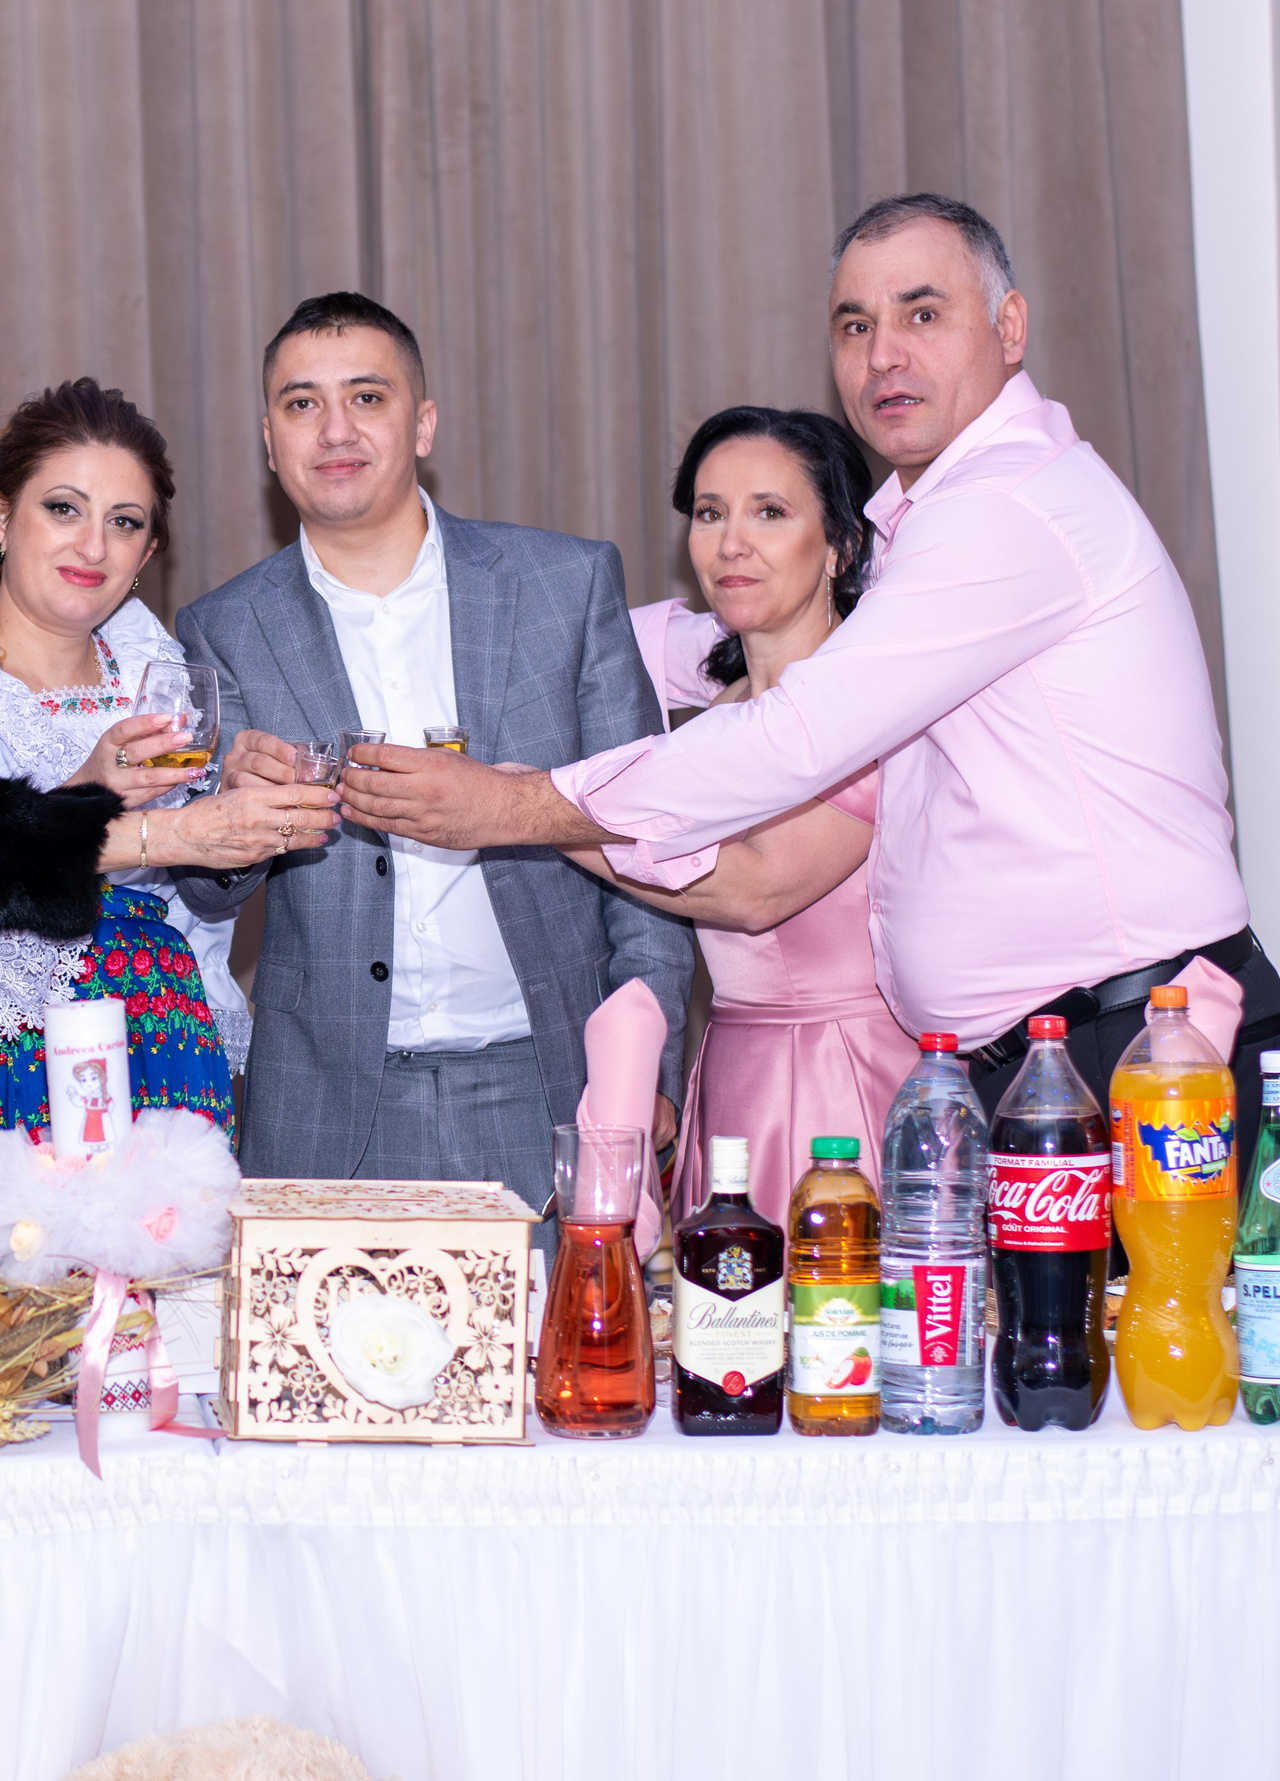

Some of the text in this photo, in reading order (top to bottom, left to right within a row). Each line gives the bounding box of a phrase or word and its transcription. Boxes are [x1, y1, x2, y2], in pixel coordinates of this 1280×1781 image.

[1165, 1136, 1227, 1168] FANTA
[994, 1157, 1074, 1167] FORMAT FAMILIAL
[1002, 1223, 1068, 1233] GOÛT ORIGINAL
[687, 1302, 778, 1330] Ballantine's
[925, 1273, 954, 1341] Vittel
[715, 1330, 752, 1338] FINEST
